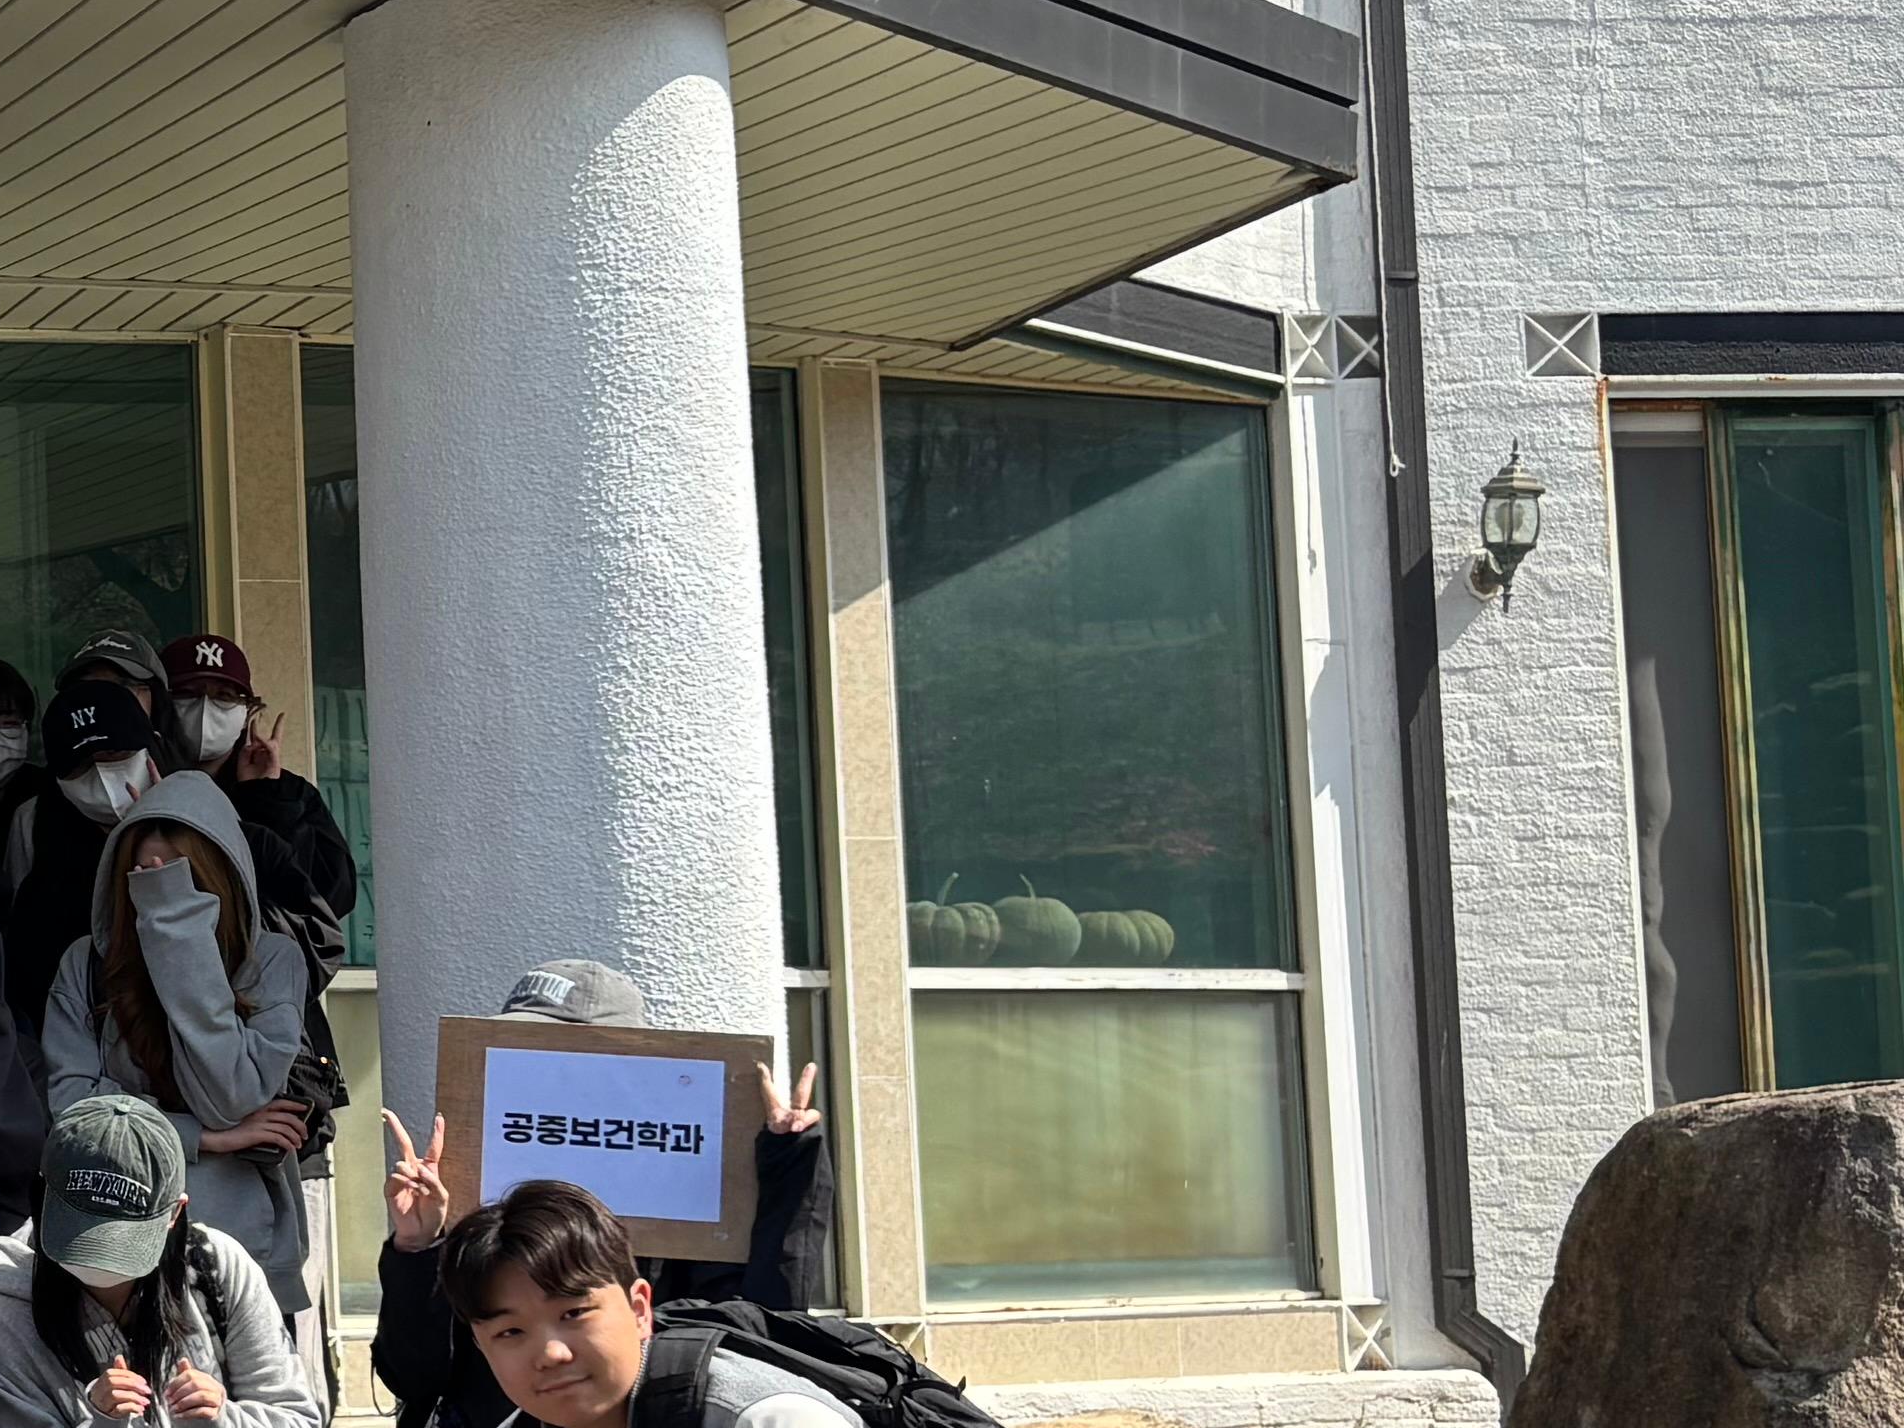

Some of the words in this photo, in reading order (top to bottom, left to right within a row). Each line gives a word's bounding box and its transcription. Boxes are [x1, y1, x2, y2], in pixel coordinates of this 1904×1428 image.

[195, 641, 225, 668] NY
[71, 706, 96, 729] NY
[502, 1111, 705, 1155] 공중보건학과
